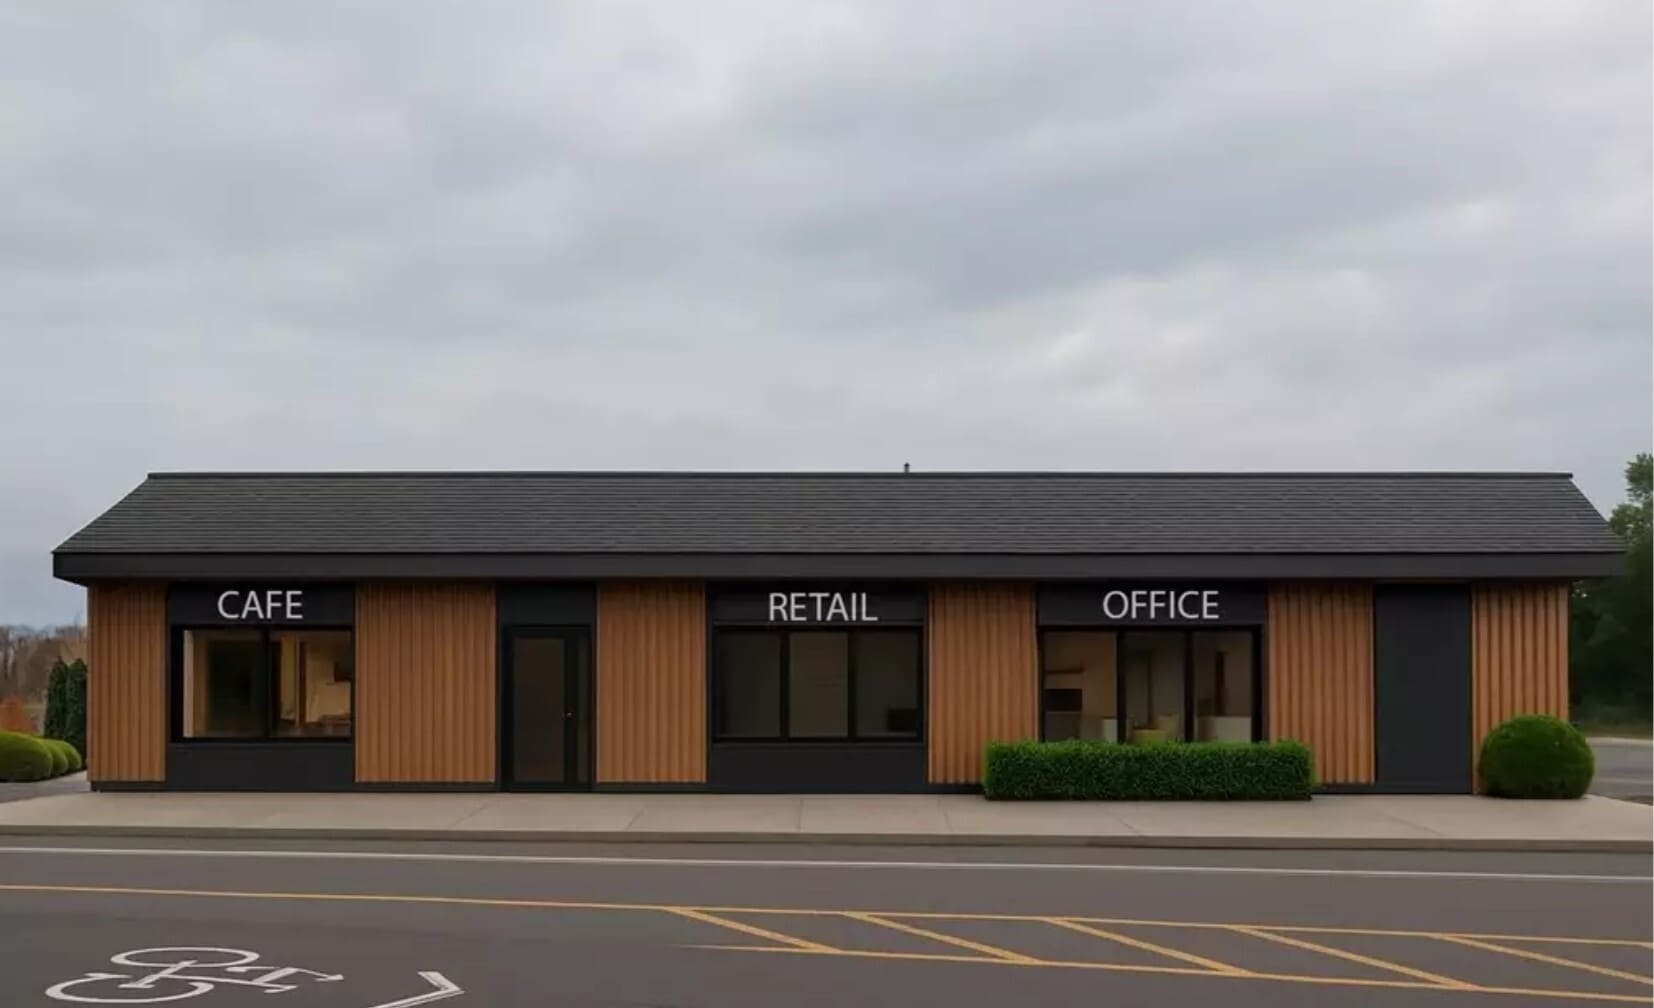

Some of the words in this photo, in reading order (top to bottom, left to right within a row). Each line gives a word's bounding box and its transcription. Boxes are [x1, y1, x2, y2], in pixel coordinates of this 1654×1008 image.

[217, 590, 303, 619] CAFE
[768, 592, 878, 621] RETAIL
[1103, 590, 1219, 619] OFFICE
